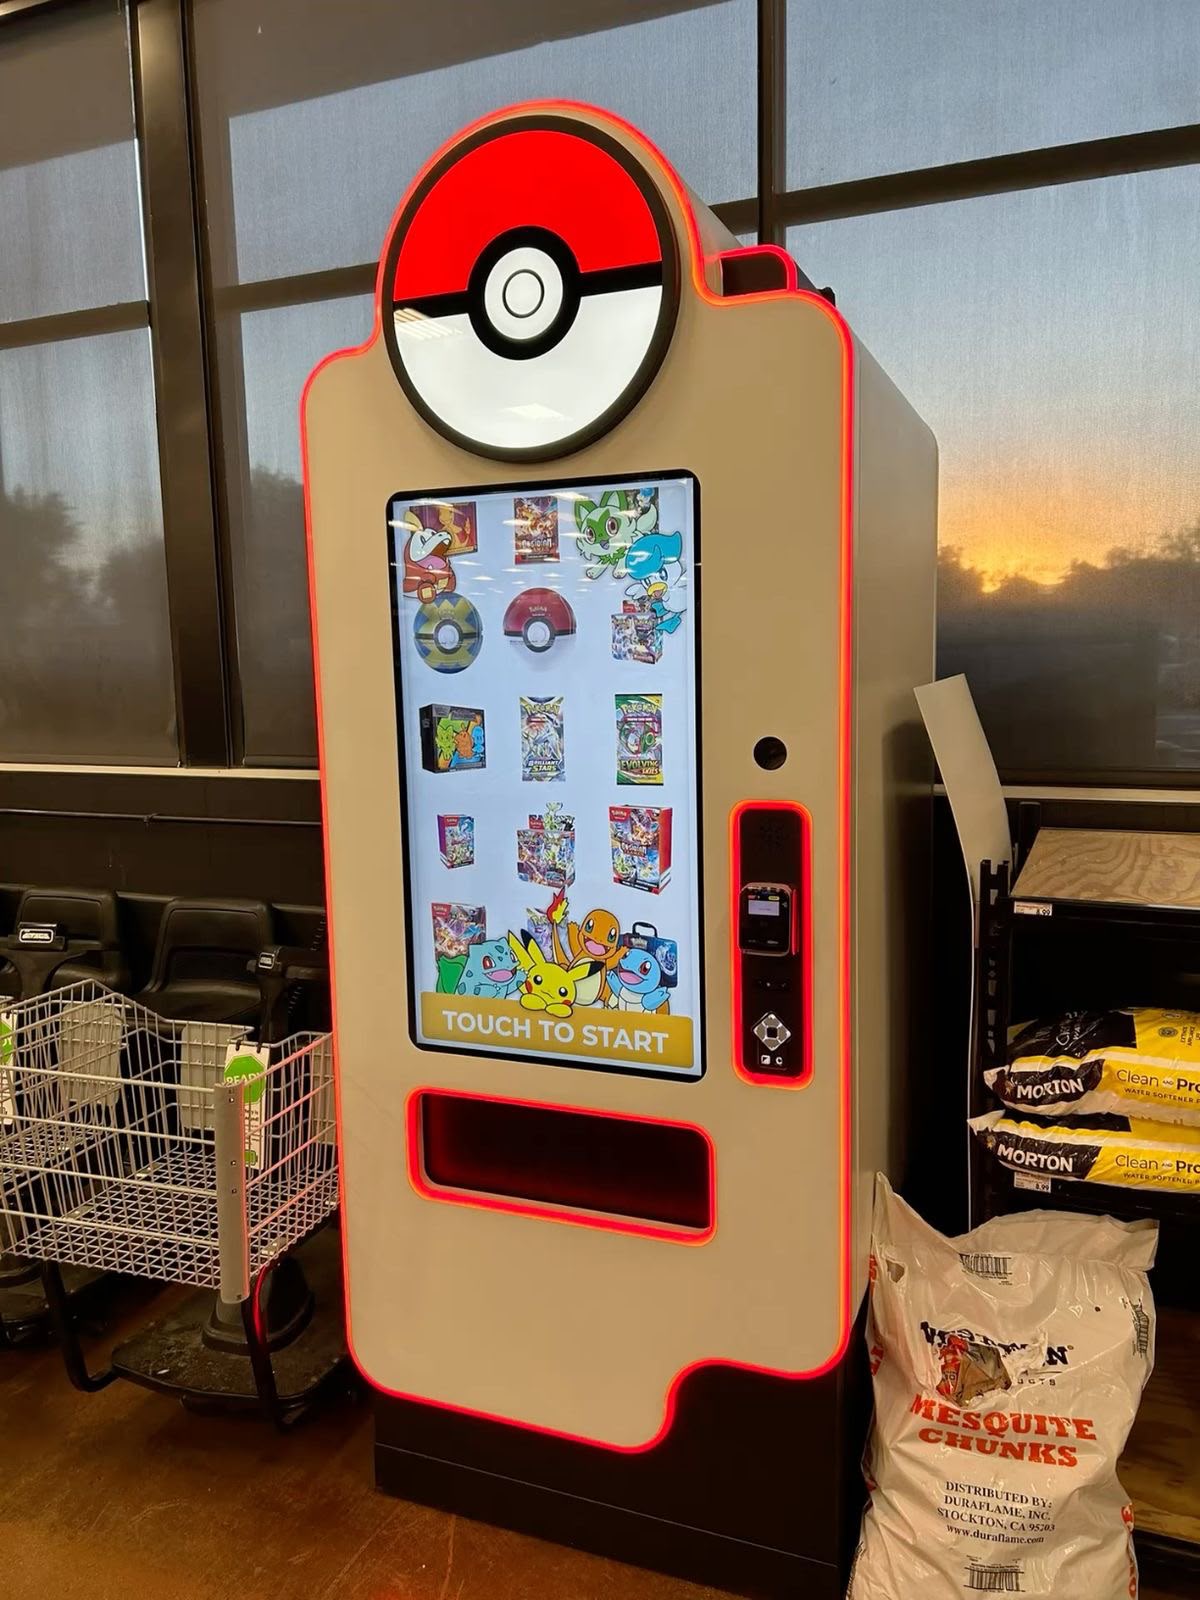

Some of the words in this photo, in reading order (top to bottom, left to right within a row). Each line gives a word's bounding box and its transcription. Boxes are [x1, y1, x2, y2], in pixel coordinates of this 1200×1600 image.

[442, 1010, 531, 1039] TOUCH
[538, 1020, 575, 1043] TO
[582, 1025, 669, 1054] START
[1016, 1078, 1085, 1099] MORTON
[1116, 1069, 1159, 1087] Clean
[1125, 1087, 1151, 1097] WATER
[1152, 1091, 1194, 1104] SOFTENER
[997, 1143, 1073, 1173] MORTON
[1115, 1154, 1159, 1170] Clean
[1152, 1175, 1193, 1184] SOFTENER
[910, 1393, 1097, 1441] MESQUITE
[918, 1427, 1078, 1468] CHUNKS
[944, 1494, 1026, 1519] DURAFLAME,
[1028, 1510, 1051, 1521] INC.
[945, 1481, 1029, 1505] DISTRIBUTED
[1032, 1496, 1052, 1509] BY:
[937, 1507, 1007, 1530] STOCKTON,
[1010, 1521, 1026, 1532] CA
[946, 1524, 1044, 1544] www.duraflame.com
